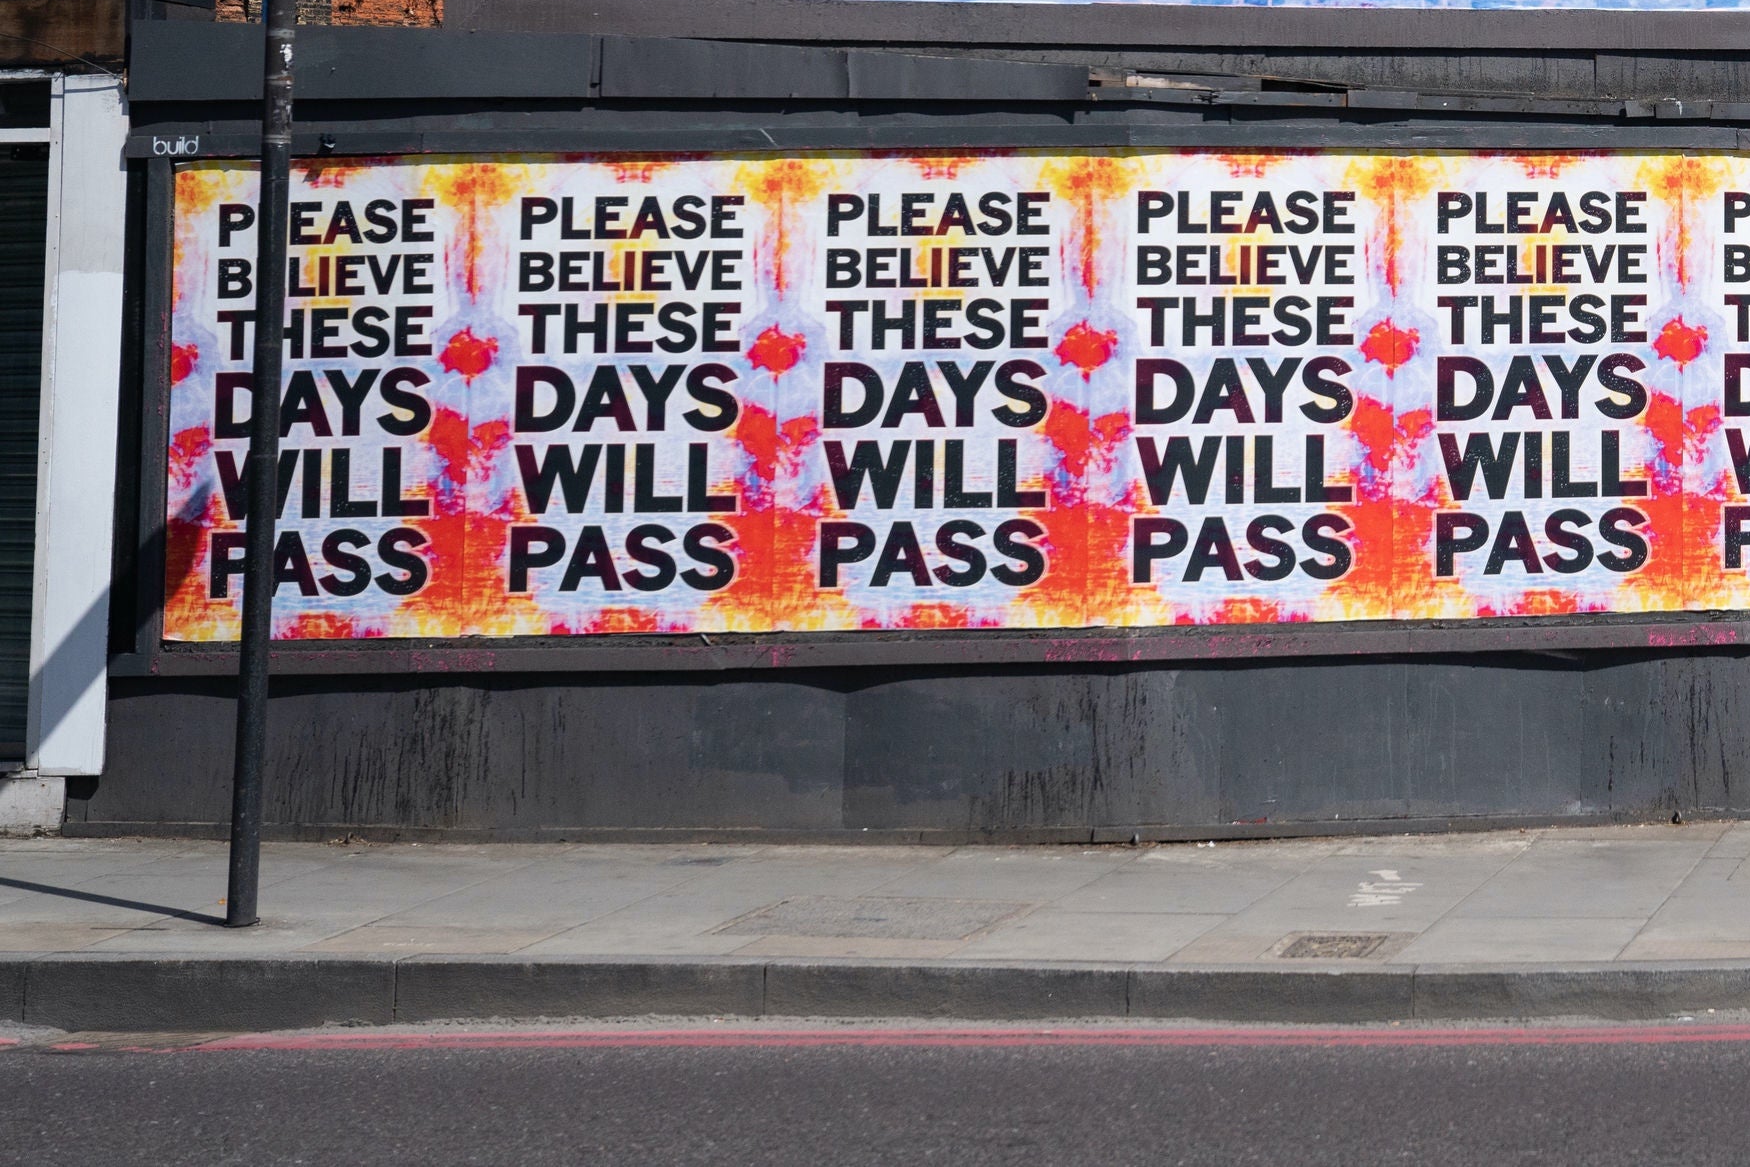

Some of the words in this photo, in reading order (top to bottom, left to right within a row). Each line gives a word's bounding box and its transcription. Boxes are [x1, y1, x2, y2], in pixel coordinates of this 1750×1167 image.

[153, 135, 199, 155] build
[218, 199, 434, 247] PEASE
[521, 196, 744, 240] PLEASE
[828, 192, 1049, 236] PLEASE
[1138, 191, 1354, 234] PLEASE
[1438, 192, 1646, 233] PLEASE
[217, 254, 434, 299] BLIEVE
[519, 251, 742, 292] BELIEVE
[827, 247, 1049, 288] BELIEVE
[1138, 246, 1354, 285] BELIEVE
[1438, 245, 1646, 284] BELIEVE
[519, 302, 741, 353] THESE
[826, 299, 1048, 350] THESE
[1137, 296, 1353, 346] THESE
[1438, 295, 1647, 344] THESE
[515, 364, 738, 432] DAYS
[824, 360, 1047, 428] DAYS
[1136, 357, 1352, 424] DAYS
[1437, 354, 1646, 421] DAYS
[515, 443, 736, 514] WILL
[824, 439, 1045, 509] WILL
[1136, 435, 1351, 505] WILL
[1438, 431, 1647, 500] WILL
[509, 524, 734, 592] PASS
[820, 519, 1044, 587] PASS
[1134, 514, 1351, 582] PASS
[1437, 508, 1647, 576] PASS
